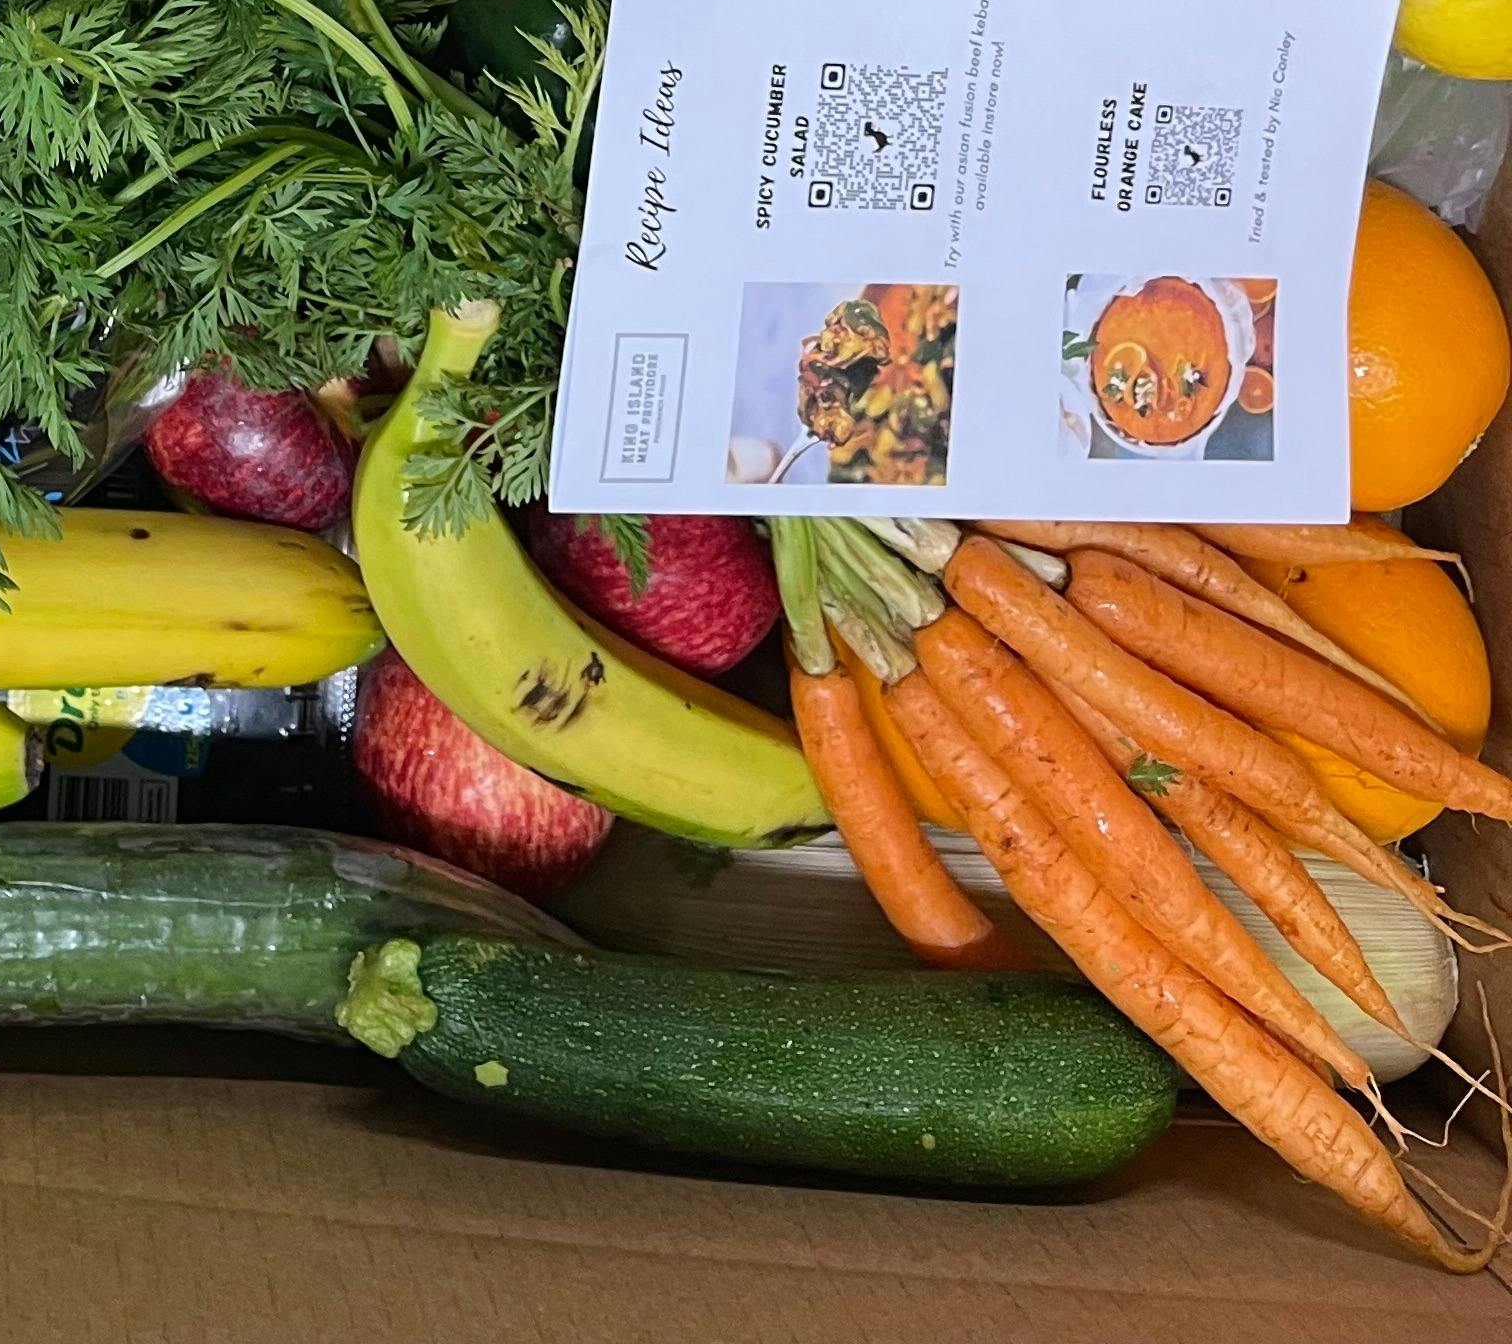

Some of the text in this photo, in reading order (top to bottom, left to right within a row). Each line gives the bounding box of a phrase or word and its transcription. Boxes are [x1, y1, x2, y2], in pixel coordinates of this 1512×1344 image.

[960, 83, 977, 129] fusion
[966, 40, 983, 77] beef
[625, 60, 683, 270] Recipe Ideas
[757, 64, 787, 229] SPICY CUCUMBER
[790, 116, 809, 178] SALAD
[958, 133, 971, 176] asian
[976, 41, 1006, 211] available instore now!
[1091, 99, 1117, 201] FLOURLESS
[1117, 82, 1148, 212] ORANGE CAKE
[1248, 30, 1296, 244] Tried & tested by Nic Conley
[948, 210, 962, 243] with
[954, 181, 965, 205] our
[944, 246, 962, 269] Try
[621, 353, 645, 463] KING ISLAND
[637, 354, 658, 463] MEAT PROVIDORE
